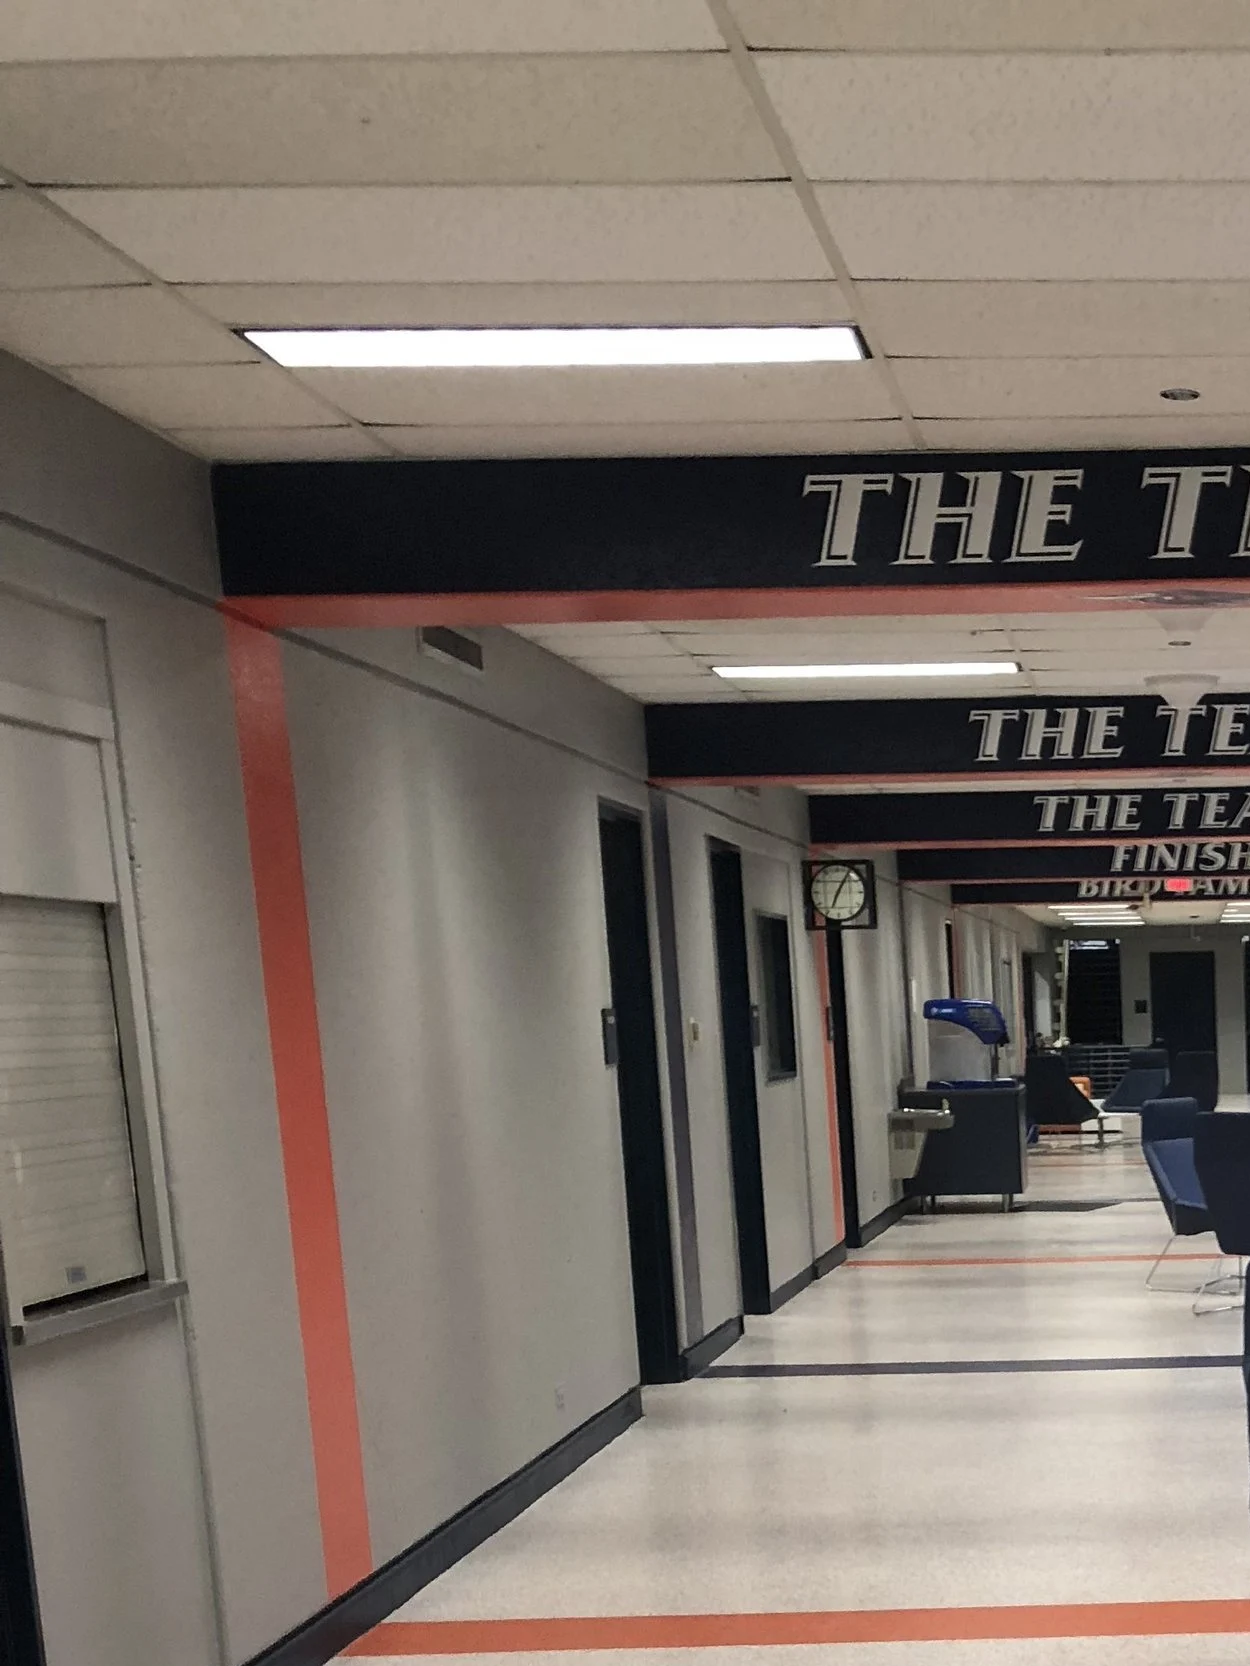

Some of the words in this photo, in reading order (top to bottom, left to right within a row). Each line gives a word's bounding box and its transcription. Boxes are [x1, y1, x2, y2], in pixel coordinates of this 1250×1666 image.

[804, 469, 1084, 567] THE
[968, 706, 1124, 761] THE
[1034, 795, 1142, 832] THE
[1077, 877, 1163, 898] BIRD
